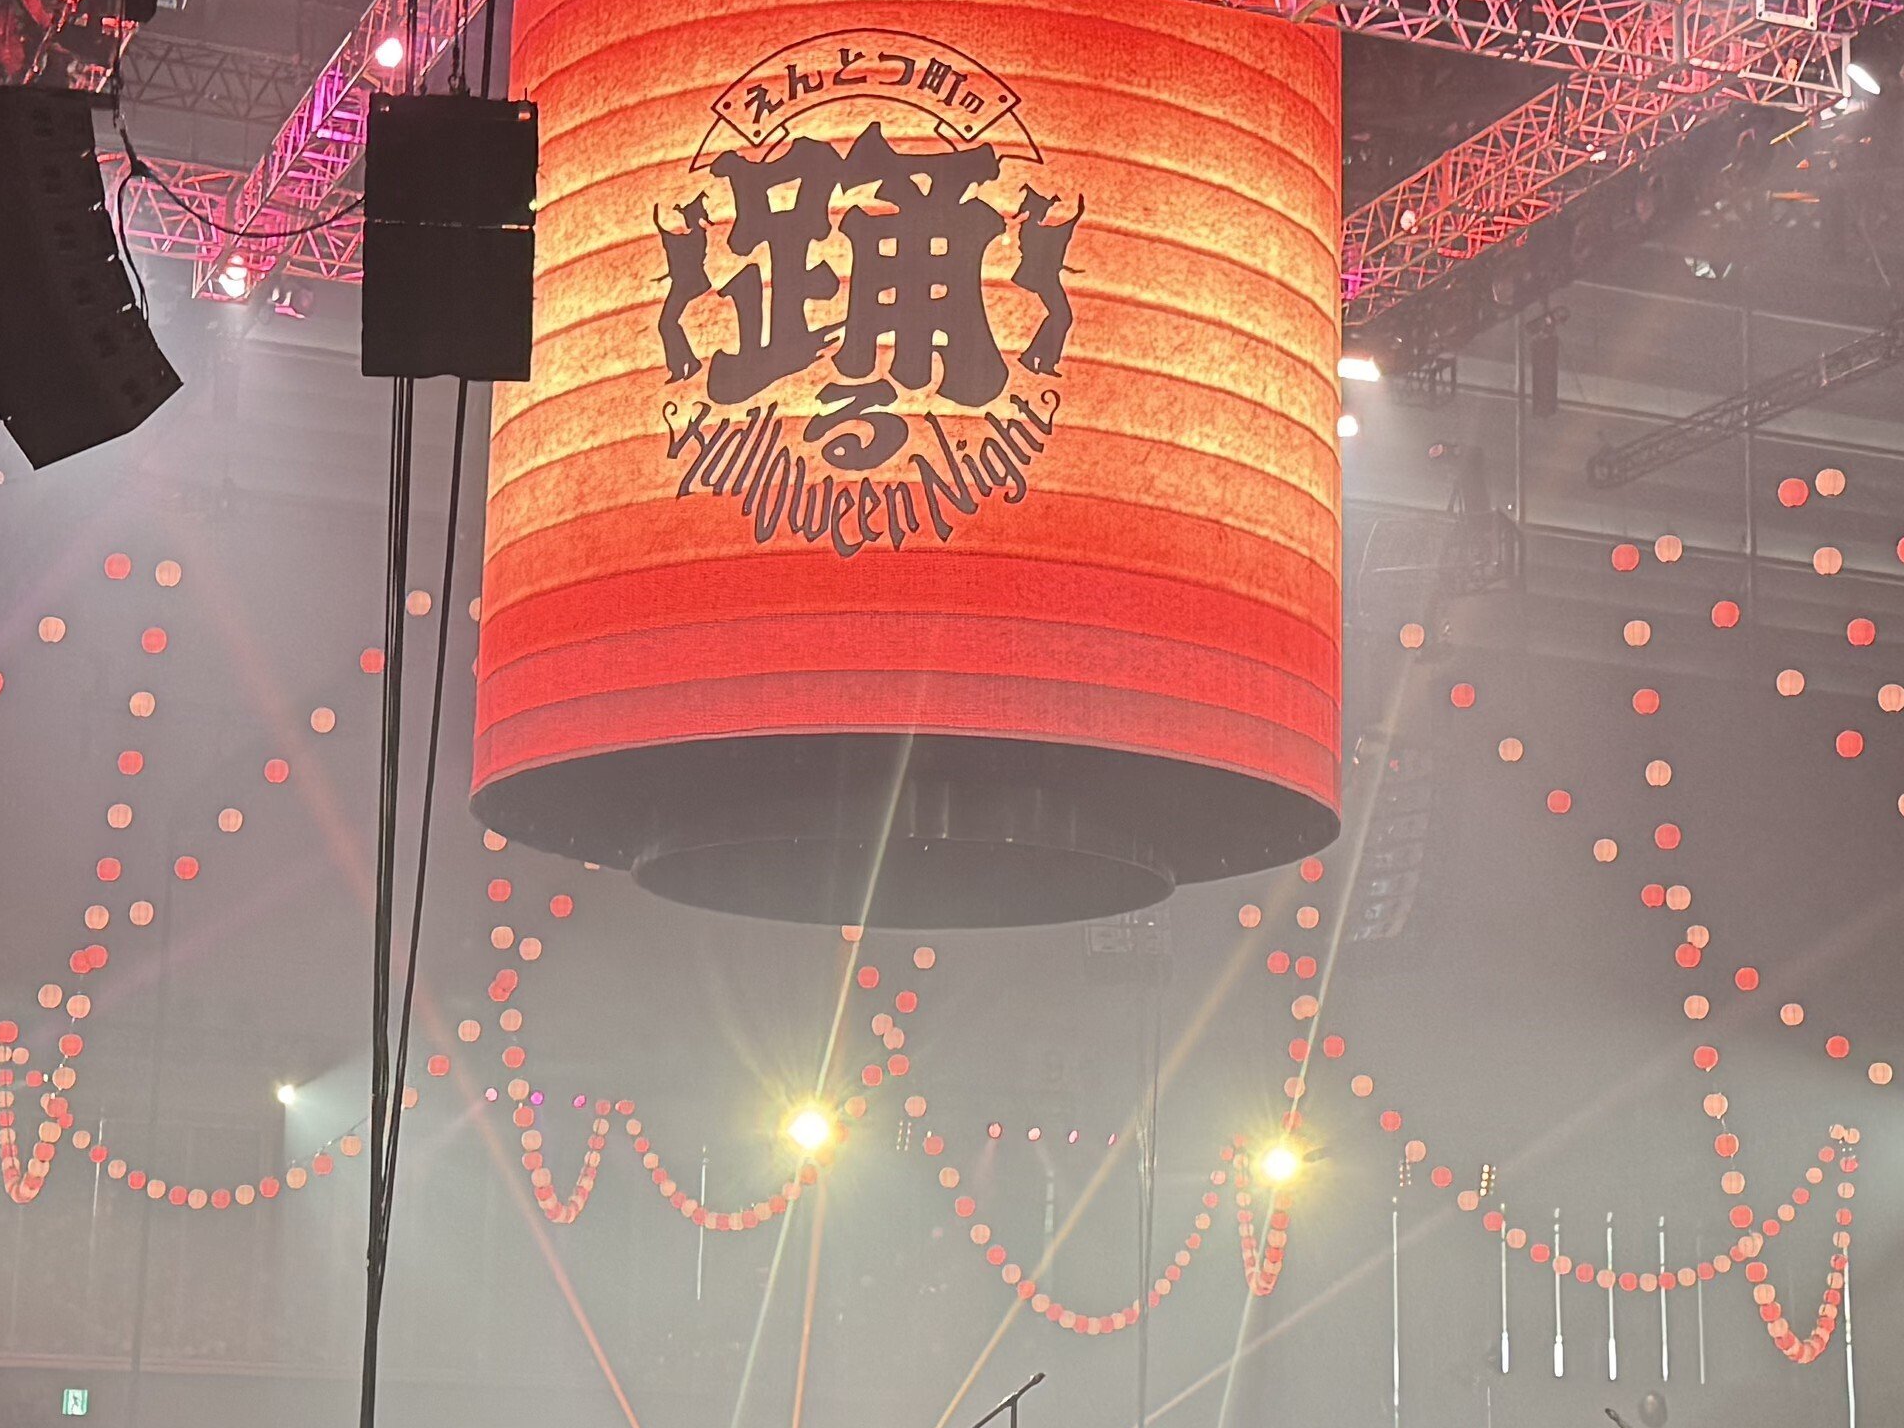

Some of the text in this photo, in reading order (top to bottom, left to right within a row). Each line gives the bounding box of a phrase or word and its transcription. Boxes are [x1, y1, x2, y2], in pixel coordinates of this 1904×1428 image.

[744, 48, 986, 125] えんとつ町の
[662, 389, 1062, 559] Halloween Night
